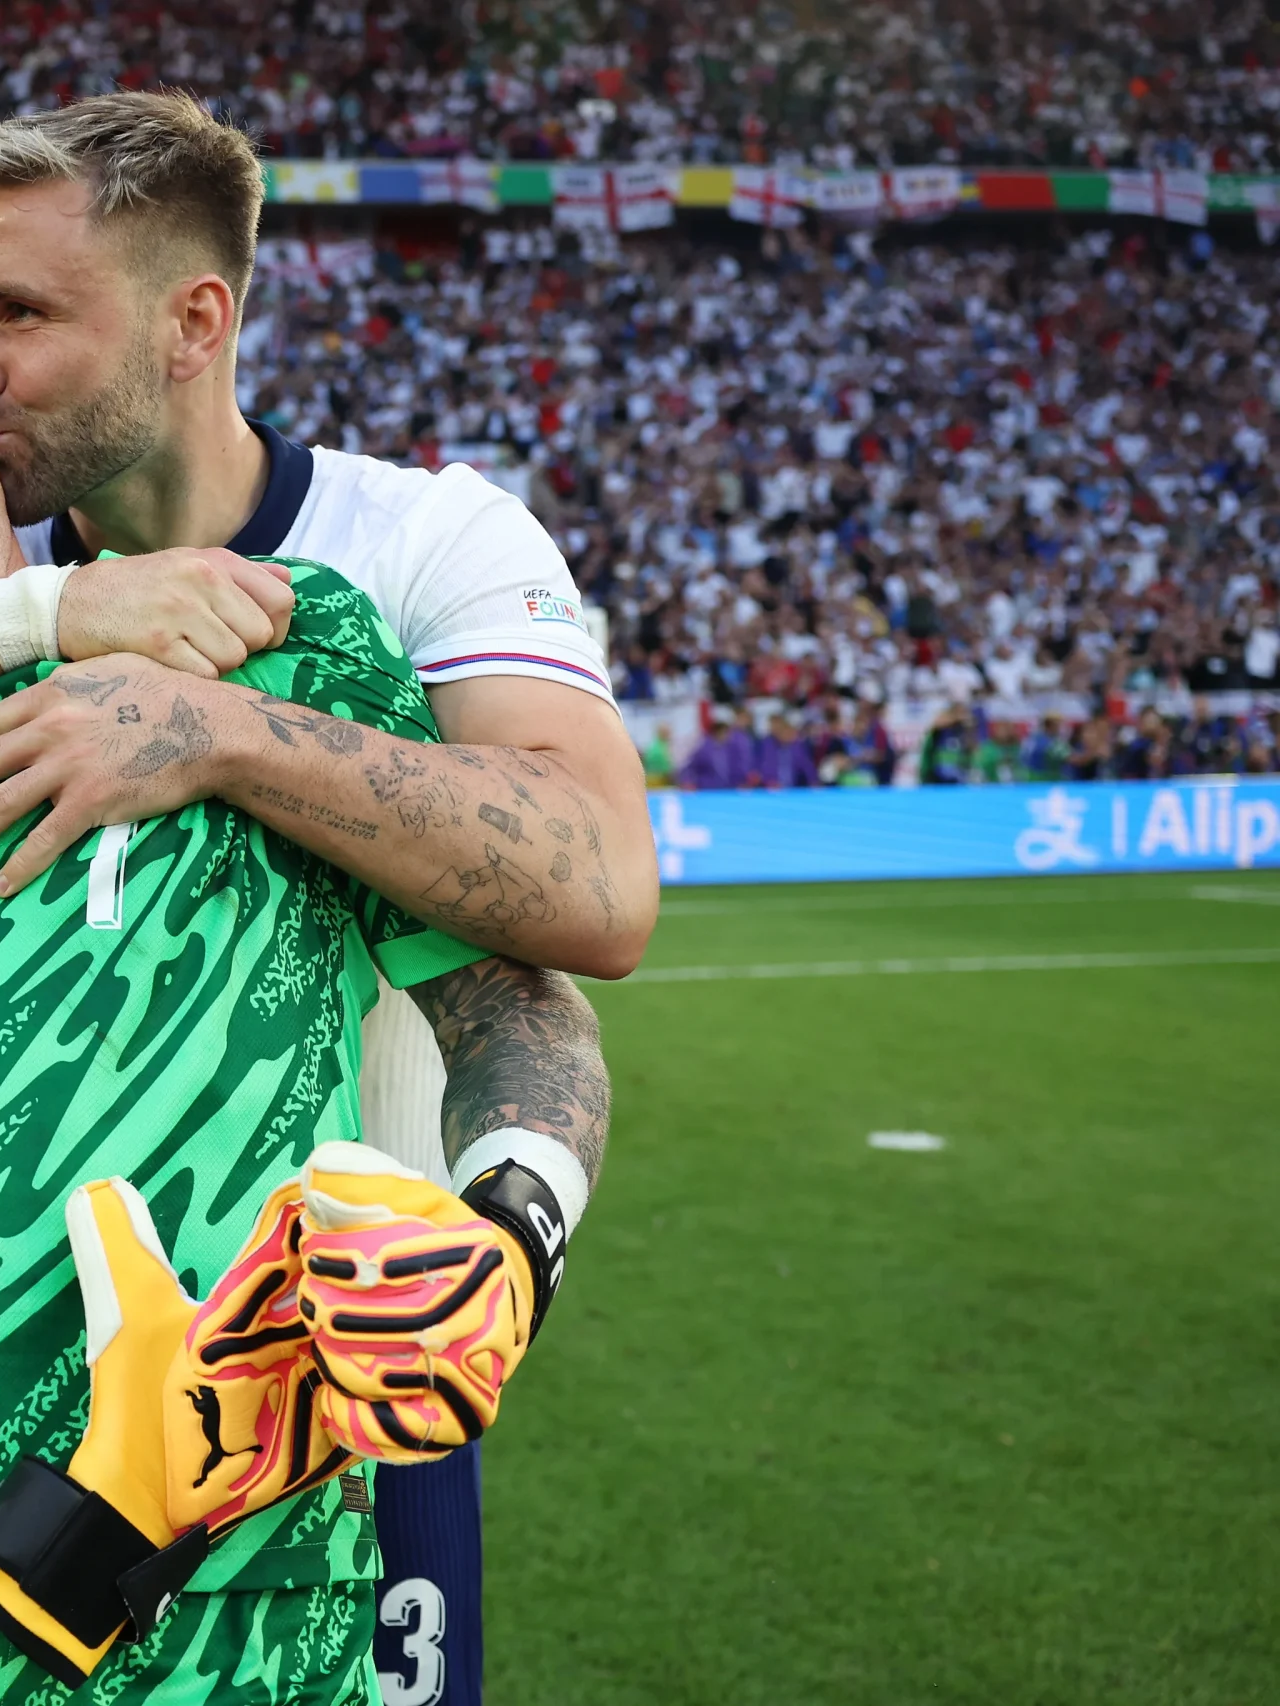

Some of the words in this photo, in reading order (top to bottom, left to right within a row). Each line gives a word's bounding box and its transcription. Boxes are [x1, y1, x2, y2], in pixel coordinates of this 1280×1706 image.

[523, 588, 552, 599] UEFA
[117, 703, 141, 724] 23
[378, 1577, 446, 1706] 3
